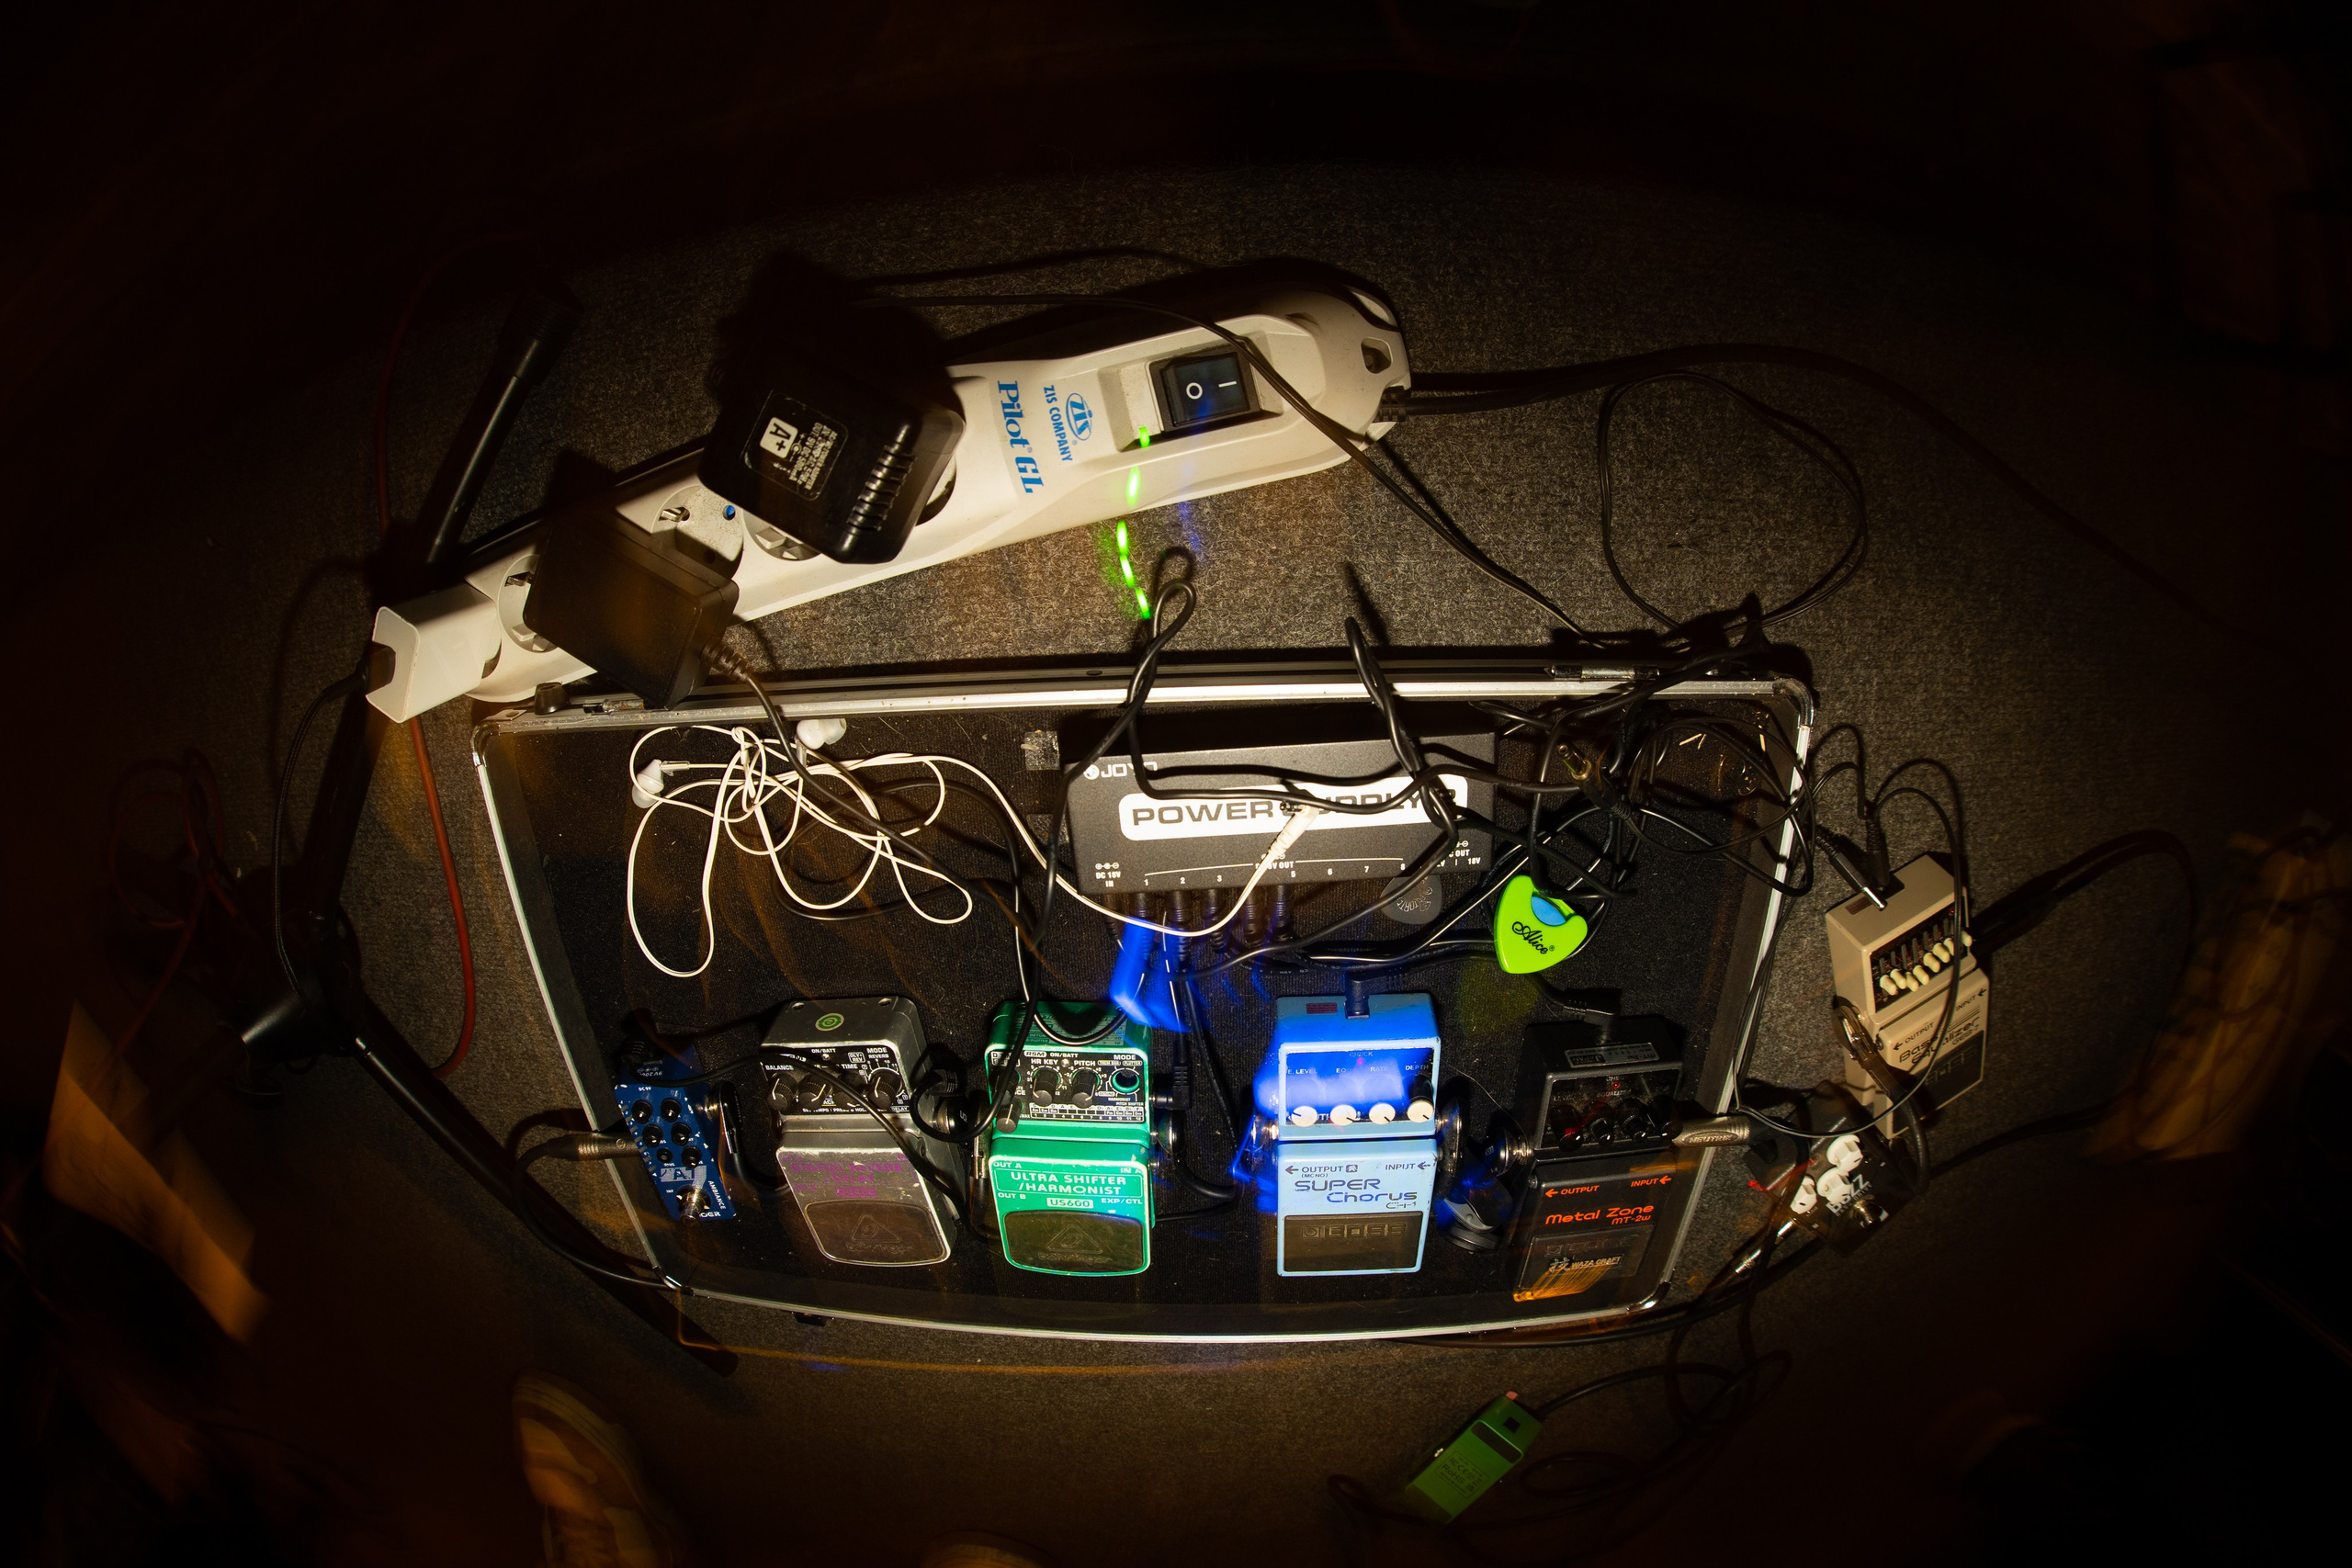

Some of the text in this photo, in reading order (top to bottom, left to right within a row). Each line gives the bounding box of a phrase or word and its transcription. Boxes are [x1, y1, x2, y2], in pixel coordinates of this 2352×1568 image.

[1043, 384, 1073, 462] ZIS COMPANY
[997, 379, 1045, 494] Pilot GL
[800, 446, 812, 458] DC
[1132, 800, 1275, 826] POWER
[1282, 790, 1423, 817] PPLY
[1455, 849, 1470, 857] OUT
[1278, 861, 1295, 869] OUT
[1467, 857, 1481, 865] 18V
[1144, 878, 1149, 886] 1
[1216, 874, 1223, 883] 3
[1290, 870, 1296, 878] 5
[1400, 863, 1406, 871] 8
[1511, 921, 1549, 954] Alice
[1905, 994, 1976, 1043] OUTPUT INPUT
[791, 1163, 903, 1173] DIGITAL REVERB
[1011, 1171, 1126, 1185] ULTRA SHIFTER
[1630, 1178, 1659, 1188] INPUT
[1019, 1182, 1122, 1195] /HARMONIST
[1294, 1179, 1381, 1191] SUPER
[1560, 1185, 1600, 1195] OUTPUT
[707, 1179, 727, 1210] AMBIANCE
[1326, 1191, 1418, 1203] Chorus
[1050, 1199, 1091, 1208] US600
[1101, 1197, 1143, 1205] EXP/CTL
[1545, 1204, 1655, 1224] Metal Zone
[1571, 1256, 1623, 1270] WAZA CRAFT
